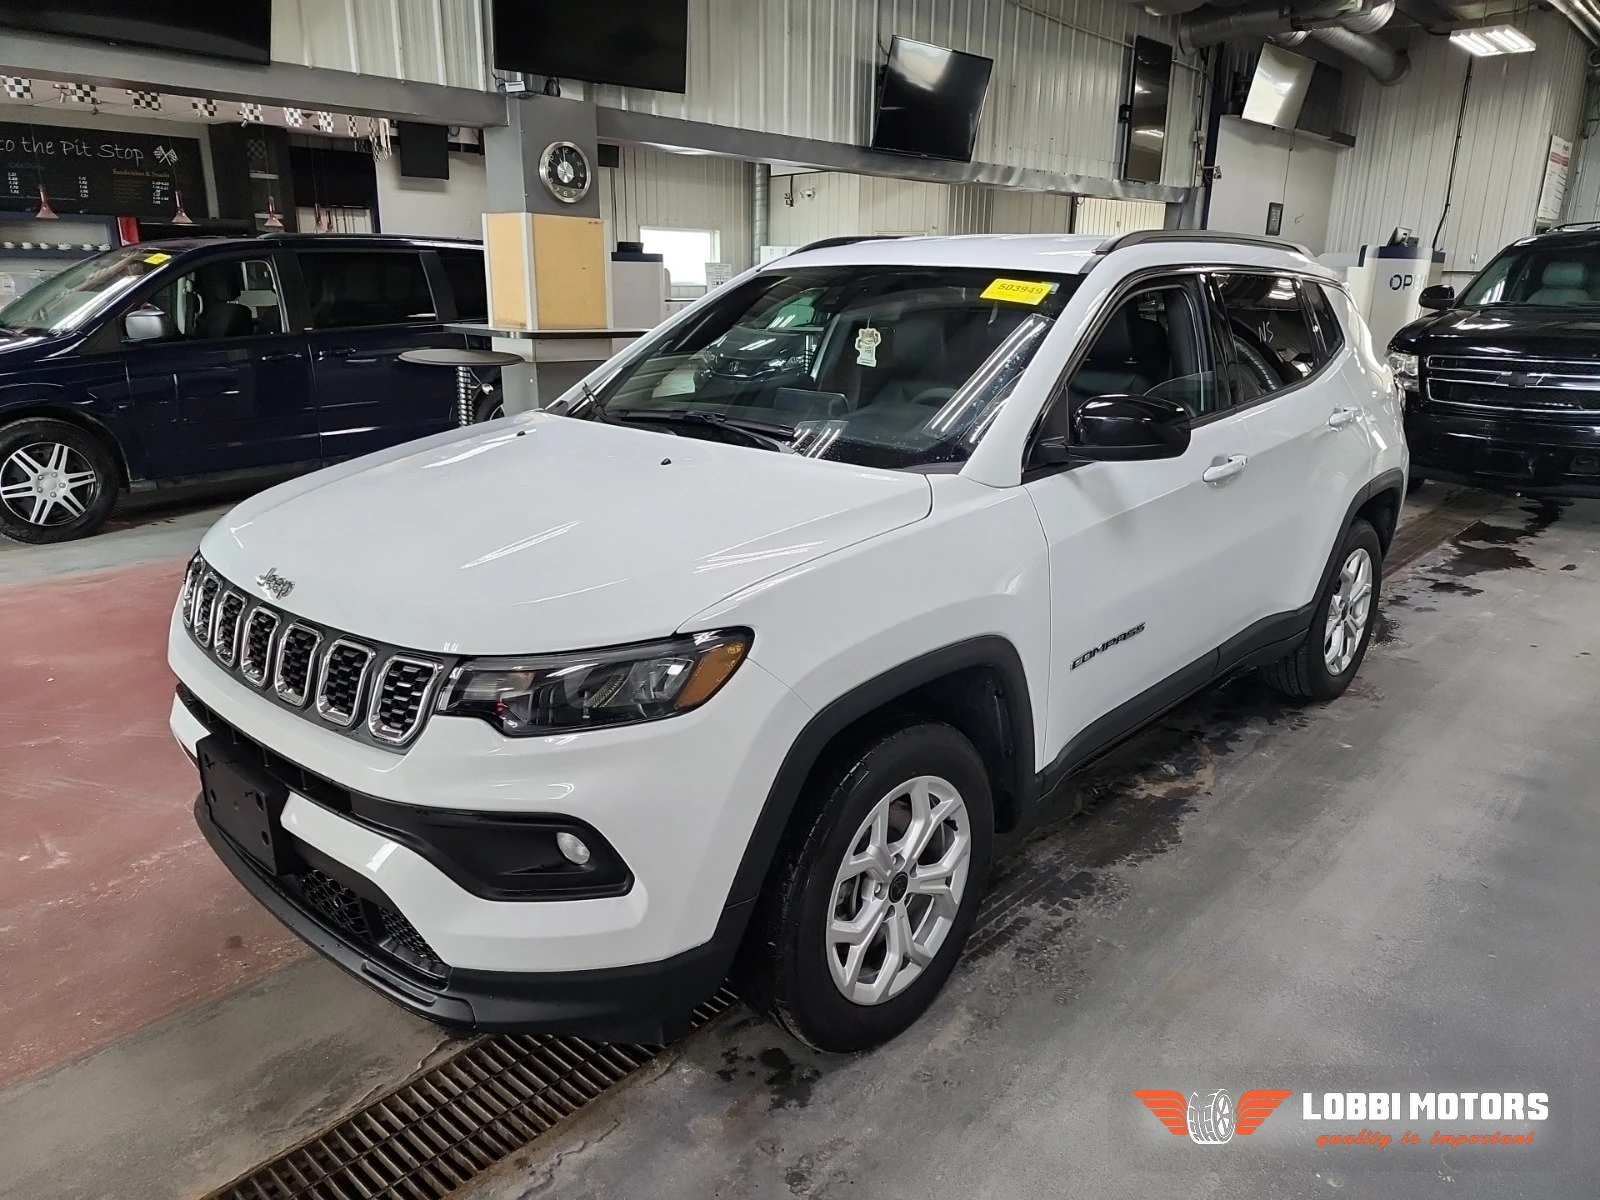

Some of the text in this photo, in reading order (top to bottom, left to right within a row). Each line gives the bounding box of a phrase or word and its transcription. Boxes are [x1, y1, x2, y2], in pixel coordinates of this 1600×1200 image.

[21, 136, 55, 155] the
[60, 139, 92, 157] Pit
[98, 144, 144, 167] Stop
[997, 283, 1044, 295] 503949
[256, 567, 295, 600] Jeep
[1069, 621, 1146, 671] COMPASS
